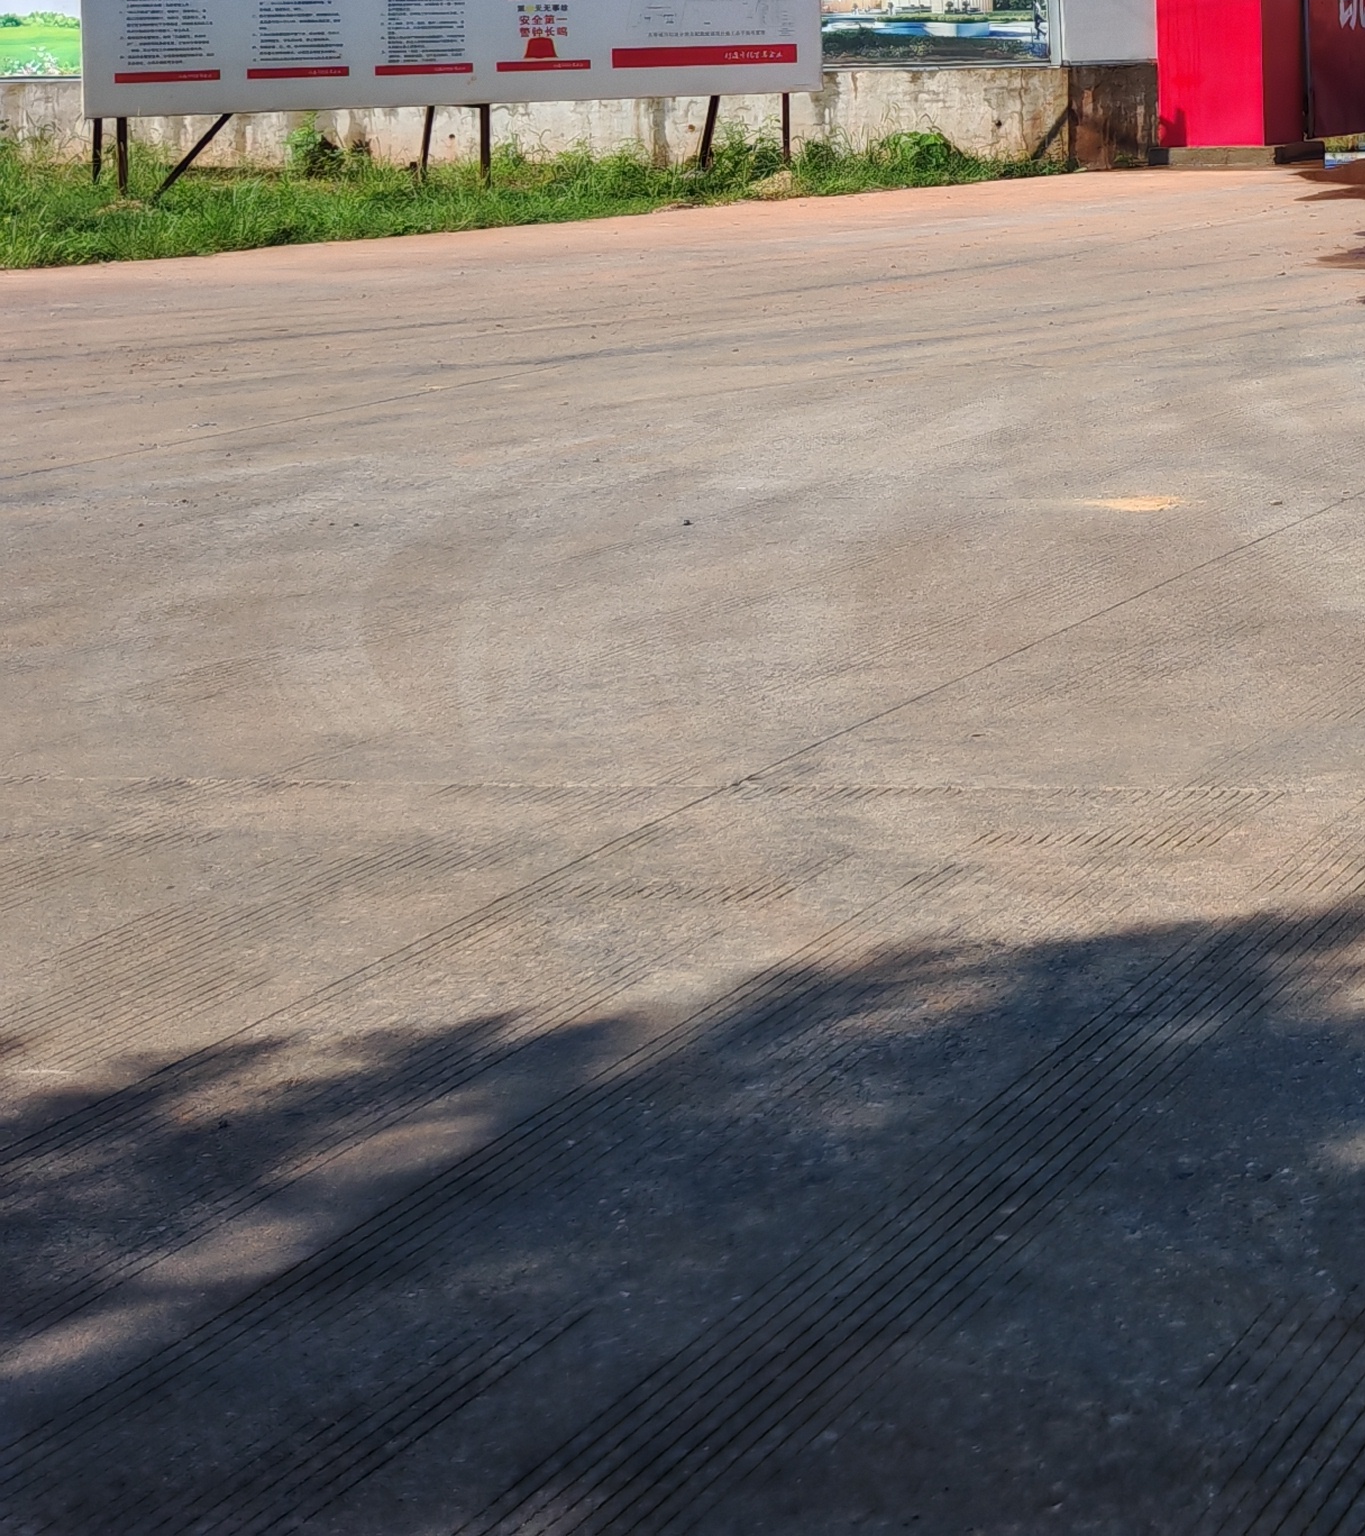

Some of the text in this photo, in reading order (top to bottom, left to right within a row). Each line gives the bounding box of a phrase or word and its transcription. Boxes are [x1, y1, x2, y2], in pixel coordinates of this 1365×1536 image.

[519, 14, 568, 26] 安全第一
[519, 26, 568, 38] 警钟长鸣
